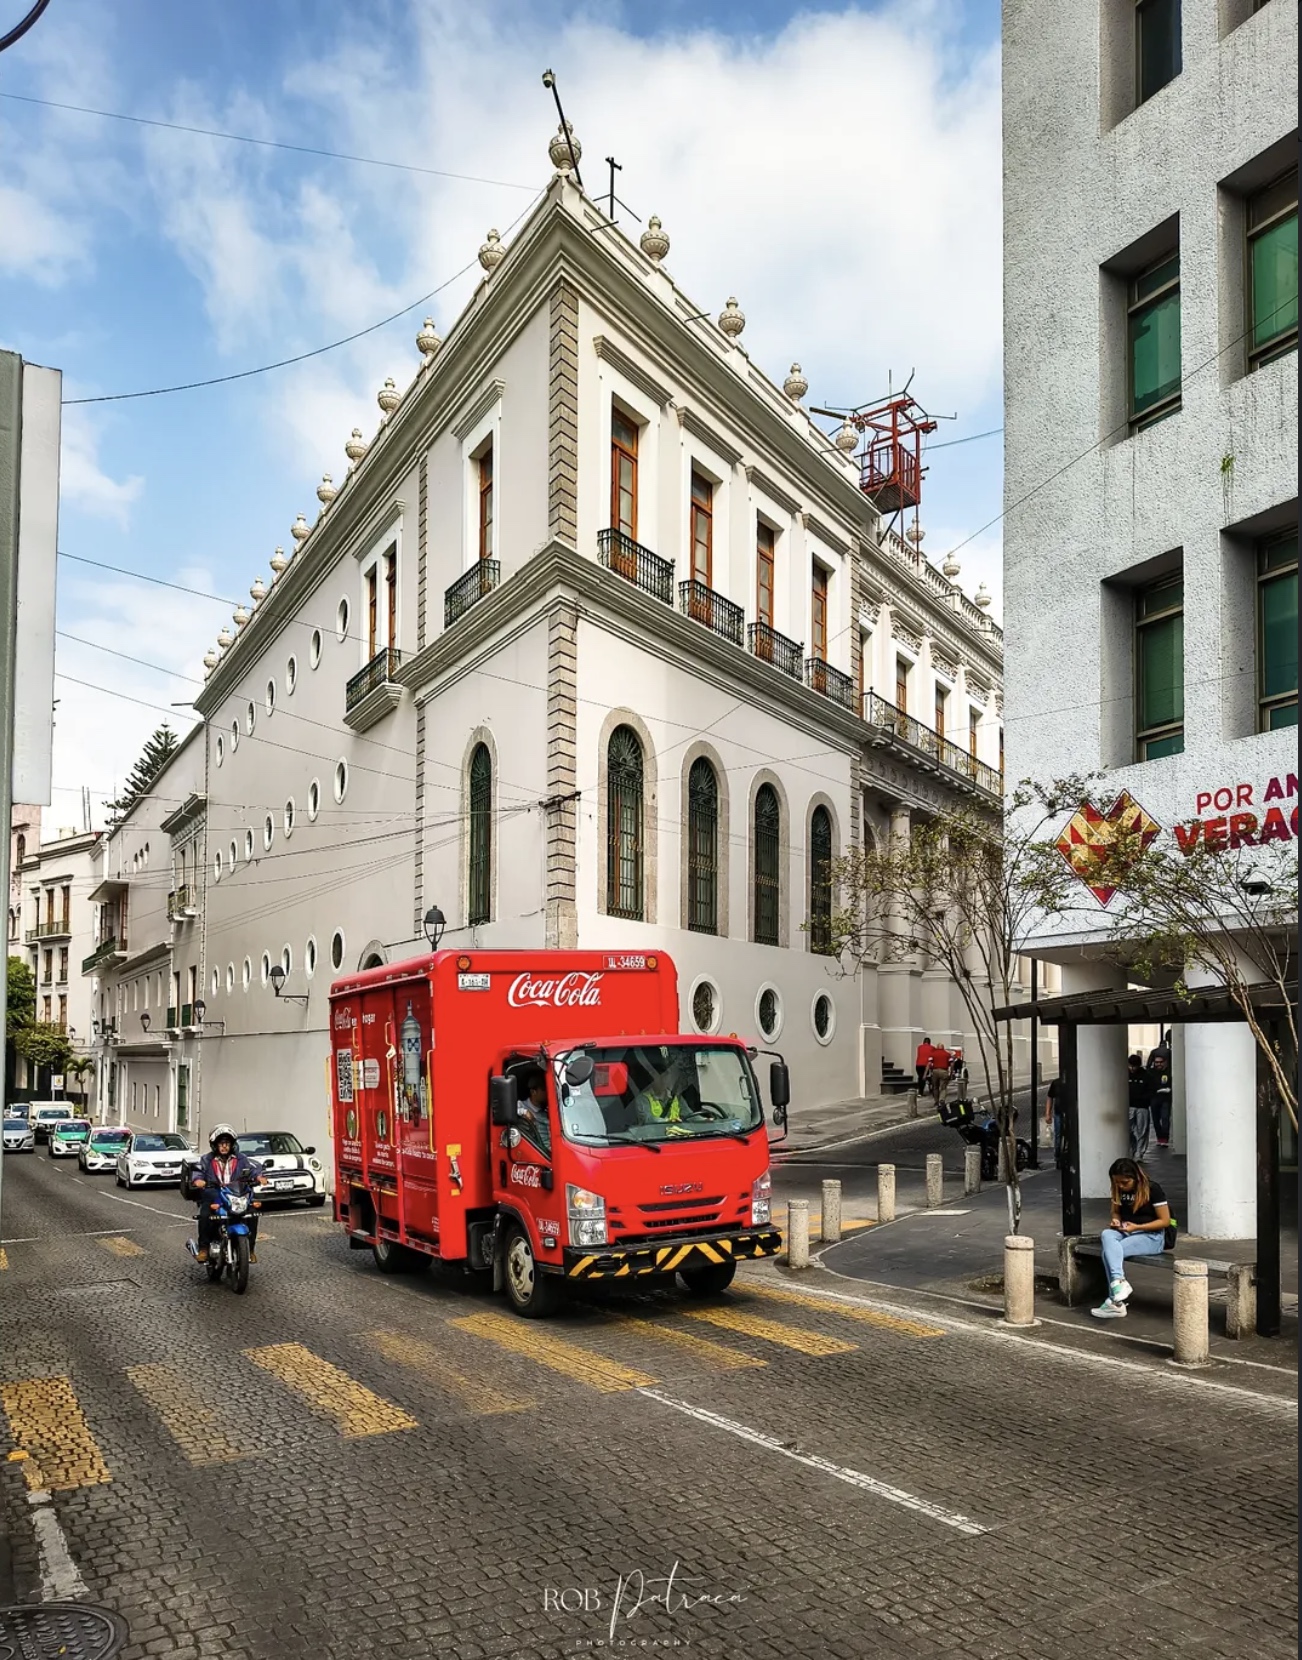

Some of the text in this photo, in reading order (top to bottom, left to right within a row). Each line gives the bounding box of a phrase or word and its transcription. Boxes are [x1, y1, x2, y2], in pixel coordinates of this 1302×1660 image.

[1196, 784, 1253, 815] POR
[1172, 805, 1298, 857] VERA
[508, 972, 604, 1008] Coca-Cola
[511, 1163, 541, 1188] Coca-Cola
[660, 1182, 703, 1195] ISUZU
